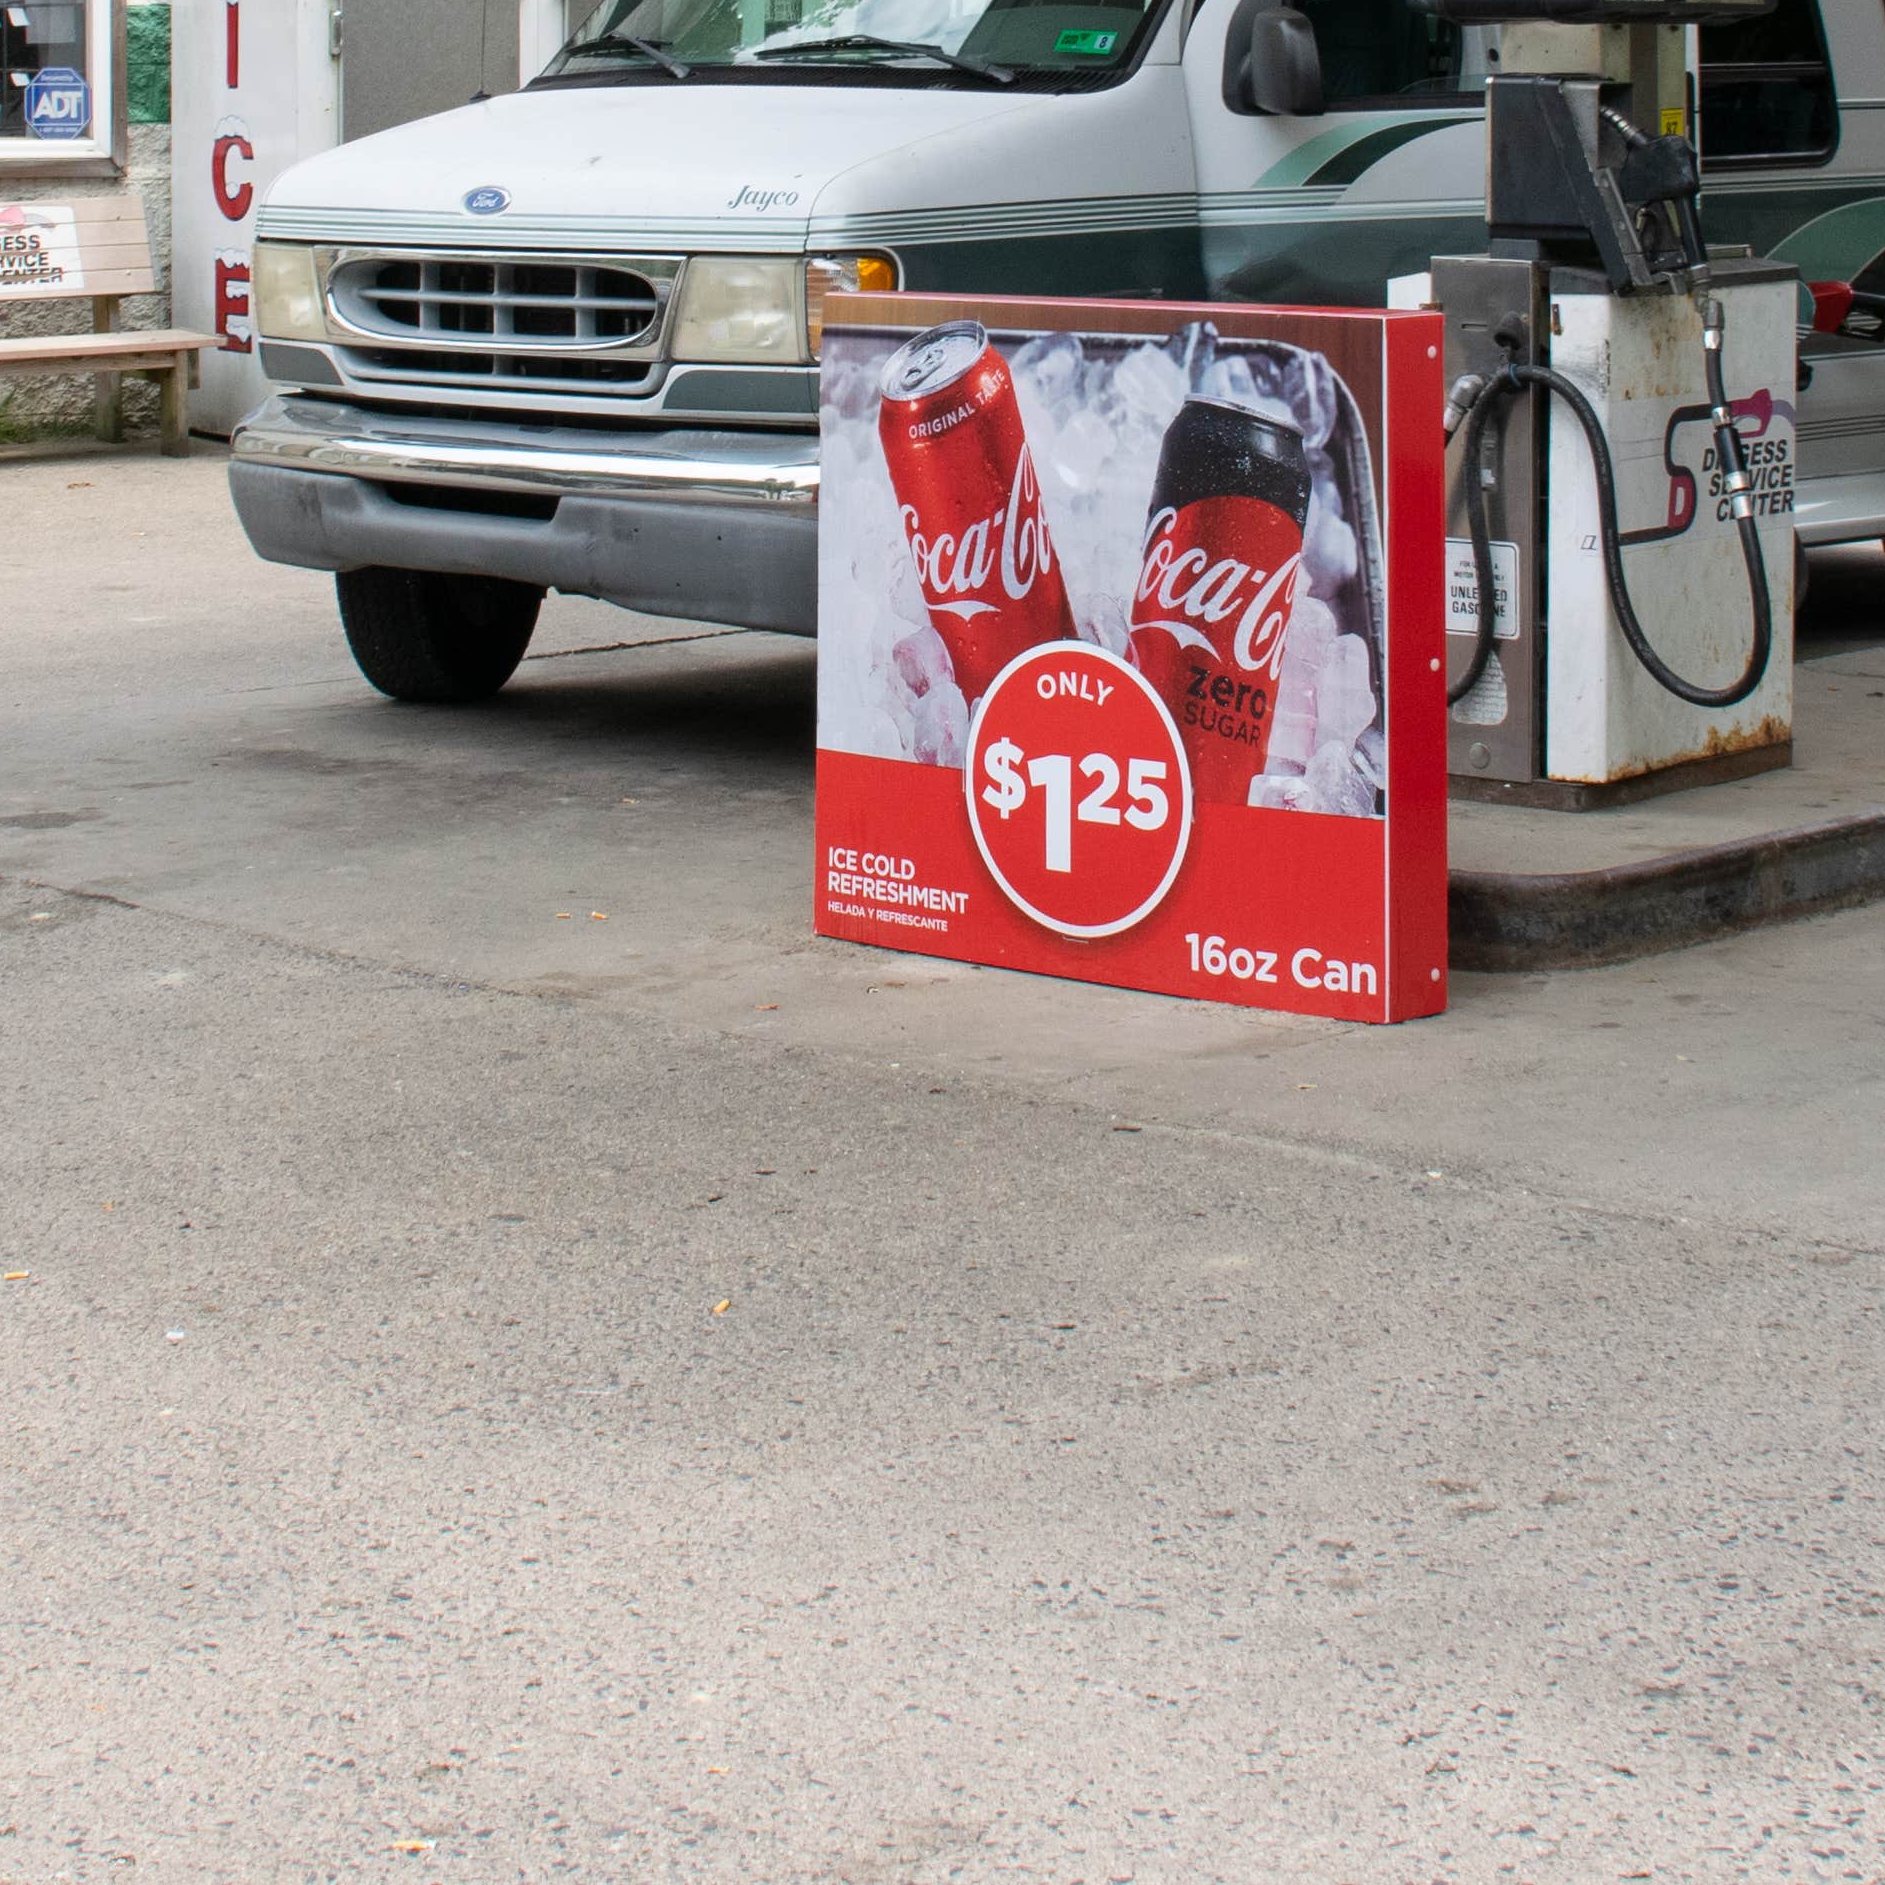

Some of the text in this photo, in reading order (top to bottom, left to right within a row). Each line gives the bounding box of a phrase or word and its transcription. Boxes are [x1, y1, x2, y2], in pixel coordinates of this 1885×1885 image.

[1099, 35, 1109, 48] 8
[33, 90, 84, 120] ADT
[471, 194, 498, 209] Ford
[727, 184, 800, 213] Jayco
[908, 401, 977, 440] ORIGINAL
[1702, 439, 1788, 472] DIGESS
[1708, 464, 1794, 498] SEVICE
[1716, 489, 1795, 522] CTER
[1450, 585, 1508, 603] UNLEED
[1452, 601, 1507, 617] GASNE
[1036, 671, 1114, 706] ONLY
[1186, 666, 1268, 721] zero
[1183, 700, 1262, 750] SUGAR
[828, 846, 915, 881] ICE COLD
[827, 871, 969, 914] REFRESHMENT
[827, 900, 949, 932] HELADA Y REFRESCANTE
[1185, 932, 1377, 996] 16oz Can
